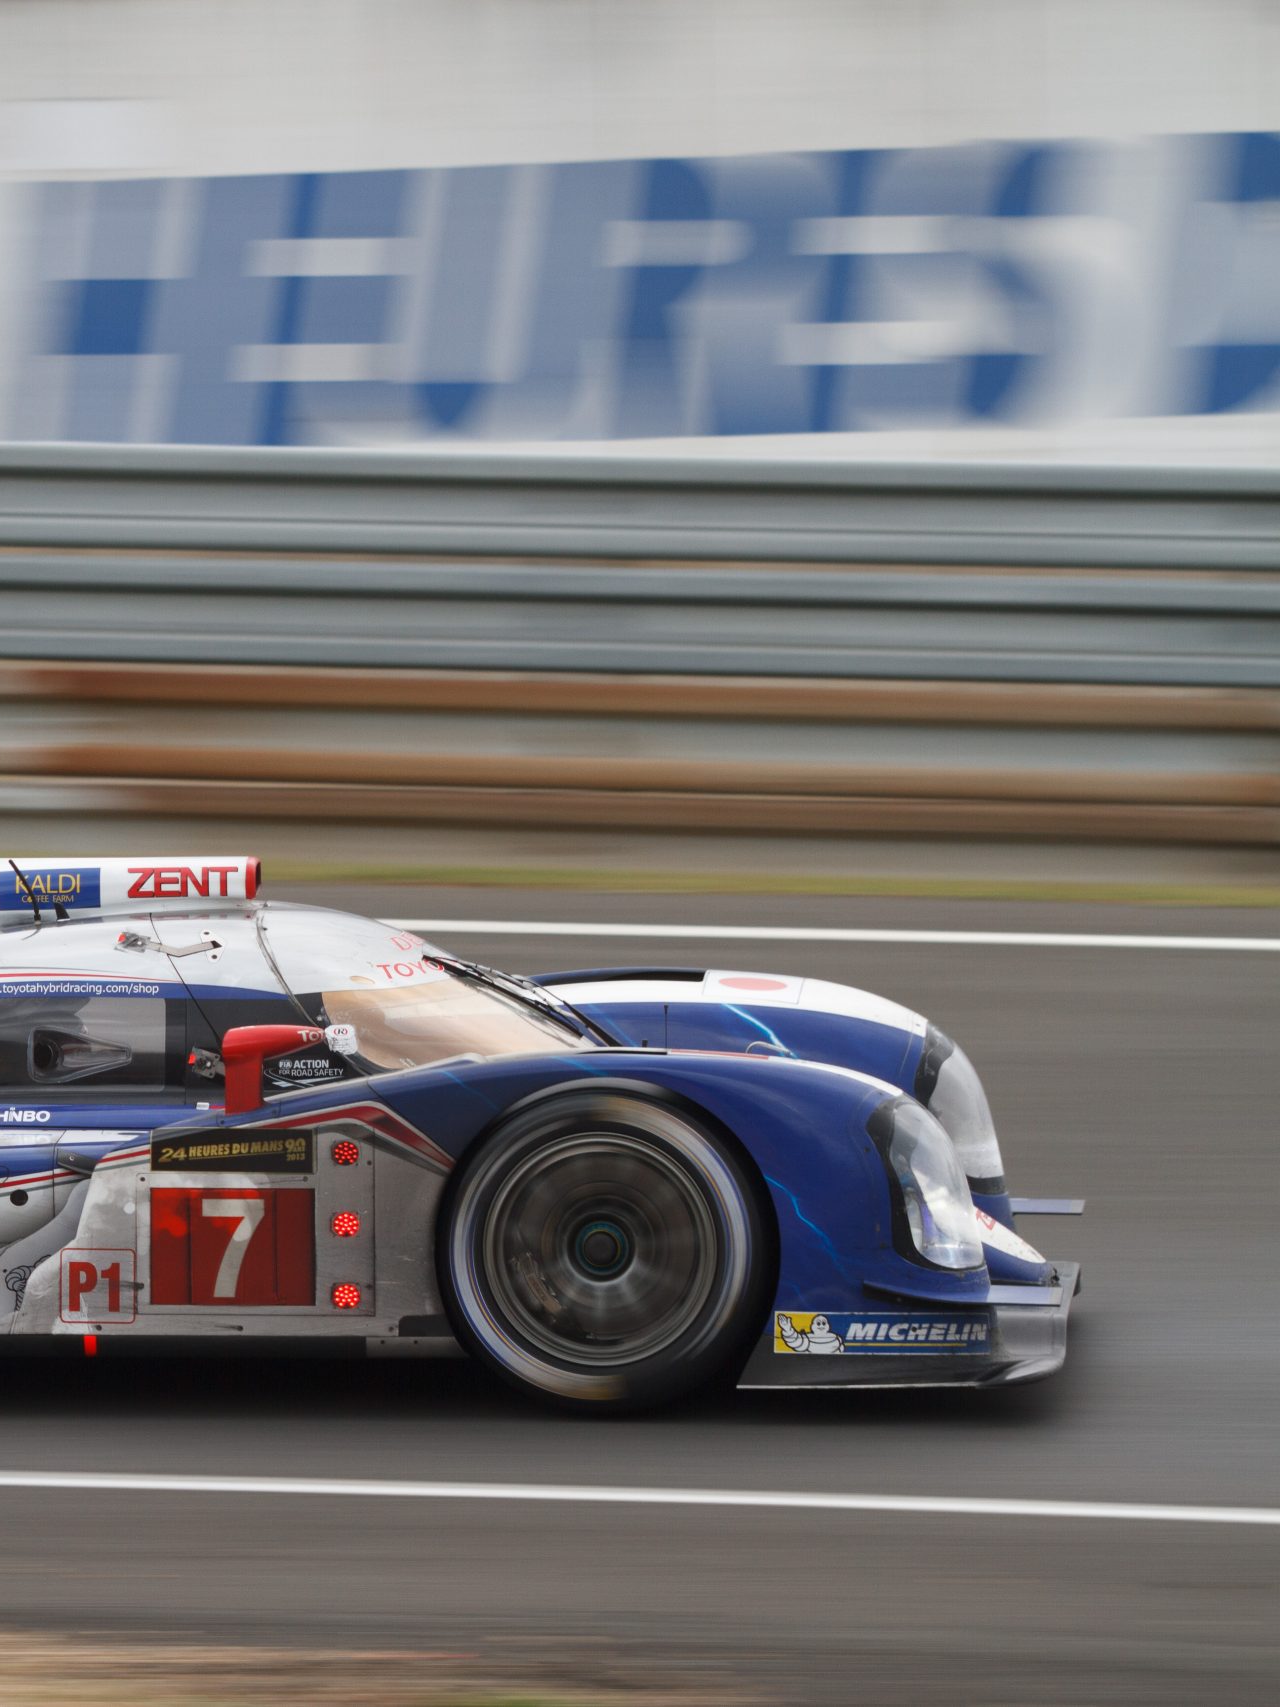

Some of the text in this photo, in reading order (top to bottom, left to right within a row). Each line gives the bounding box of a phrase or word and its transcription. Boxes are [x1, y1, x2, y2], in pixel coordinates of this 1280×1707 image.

[15, 873, 81, 894] KALDI
[126, 866, 239, 899] ZENT
[52, 894, 74, 903] FARM
[291, 1069, 313, 1077] ROAD
[314, 1068, 344, 1076] SAFETY
[293, 1059, 330, 1069] ACTION
[158, 1147, 188, 1163] 24
[188, 1143, 230, 1159] HEURES
[231, 1142, 250, 1155] DU
[250, 1140, 284, 1153] MANS
[202, 1198, 265, 1298] 7
[67, 1261, 121, 1313] P1
[845, 1322, 987, 1342] MICHELIN
